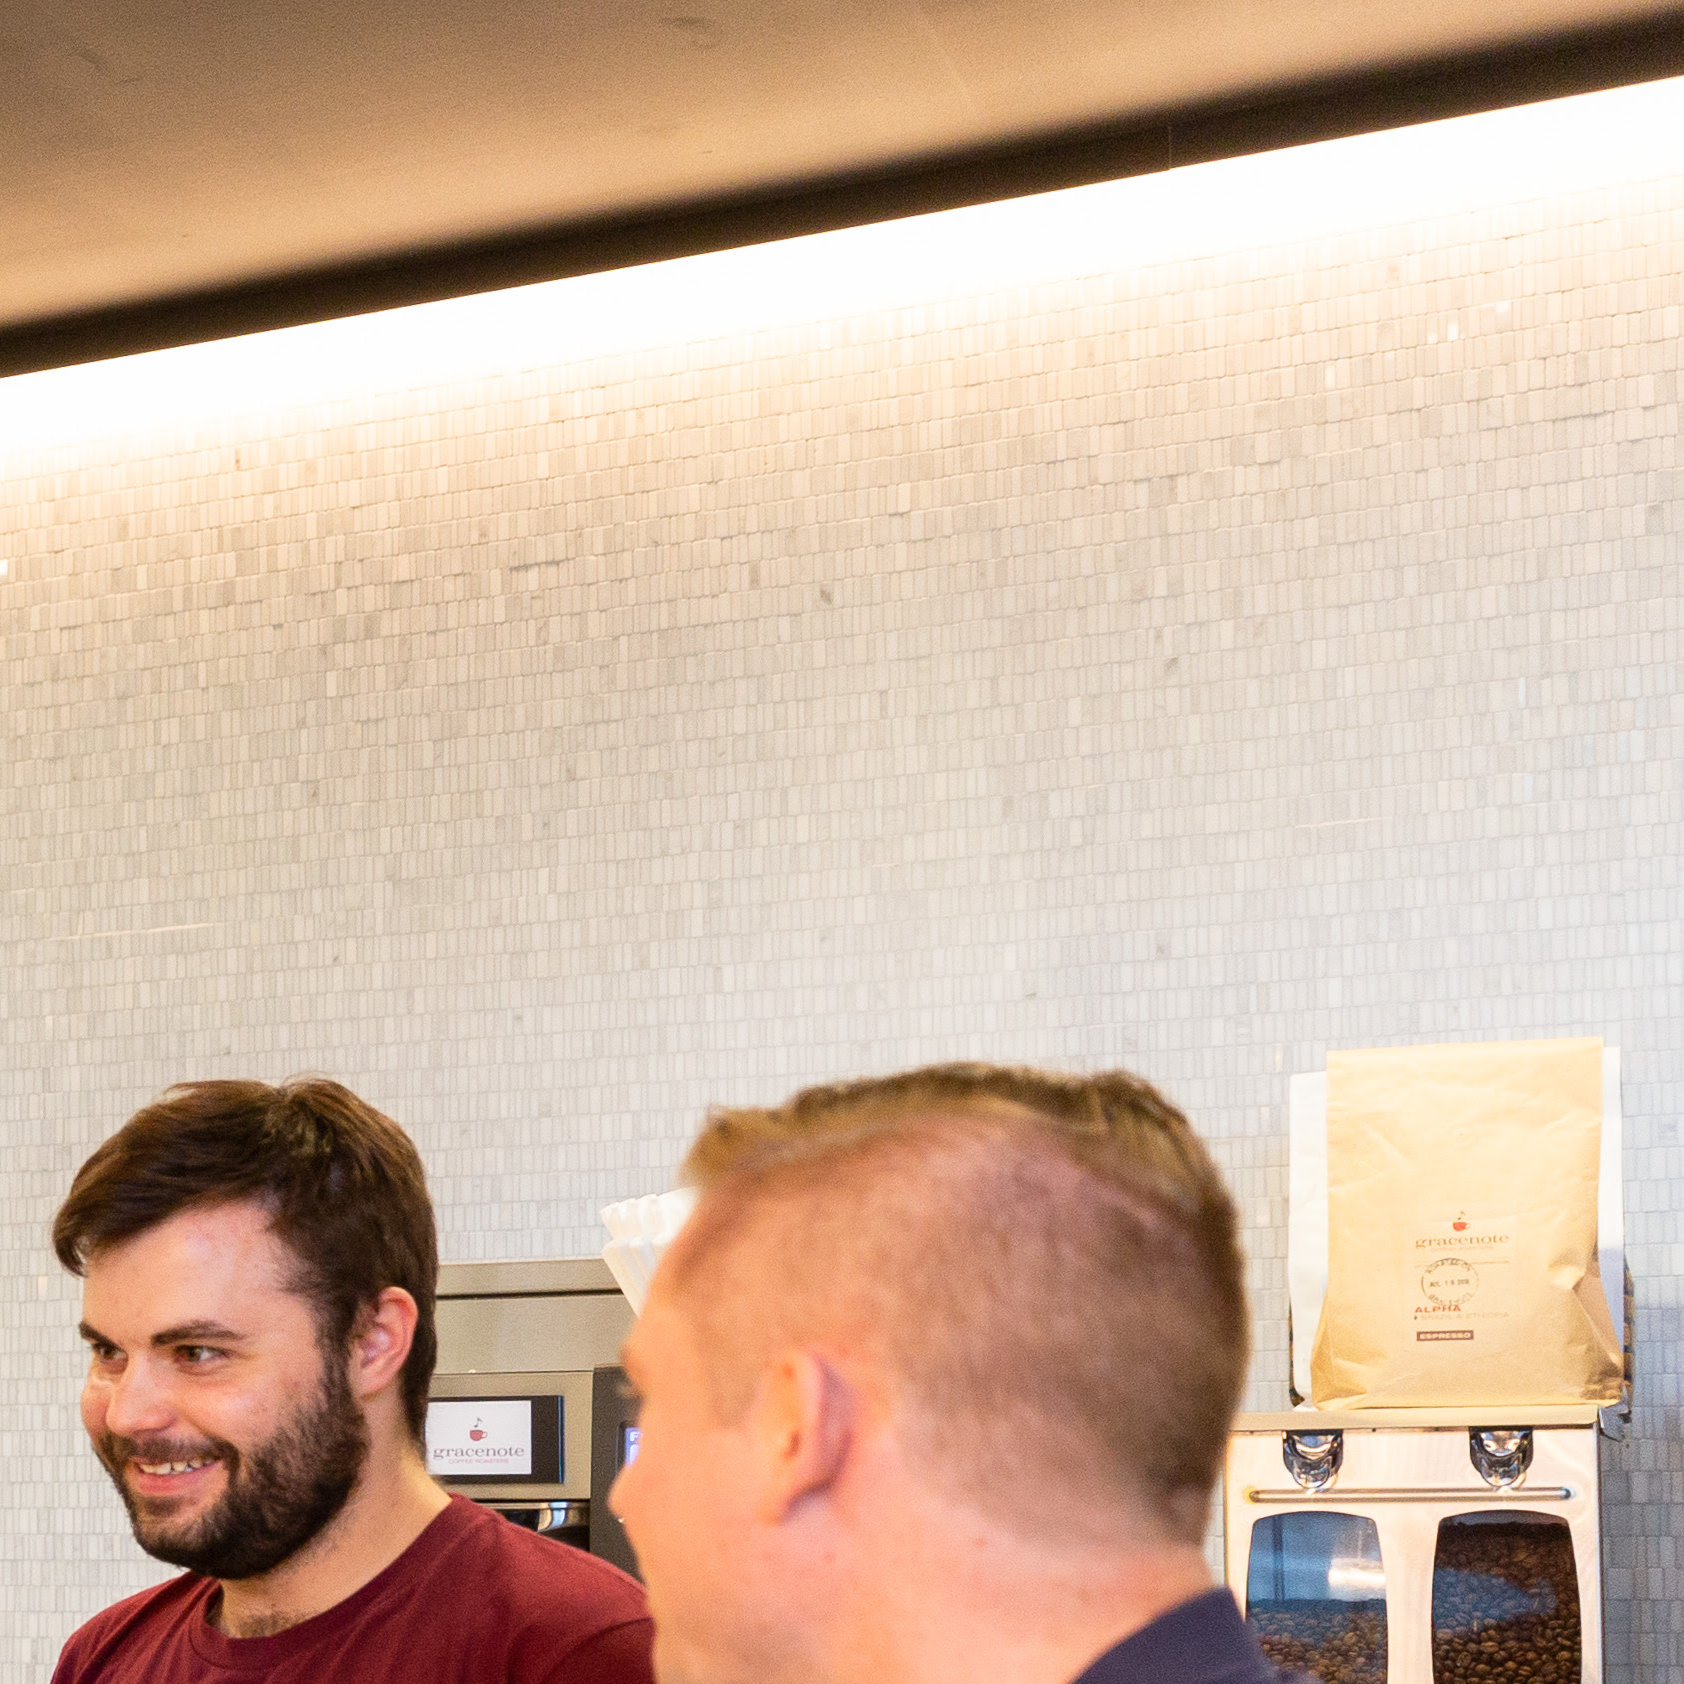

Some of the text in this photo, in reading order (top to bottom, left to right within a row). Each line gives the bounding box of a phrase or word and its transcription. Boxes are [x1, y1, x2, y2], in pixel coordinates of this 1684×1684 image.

[1414, 1234, 1510, 1248] gracenote
[1414, 1304, 1462, 1314] ALPHA
[1419, 1331, 1472, 1340] ESPRESSO
[433, 1446, 524, 1460] gracenote
